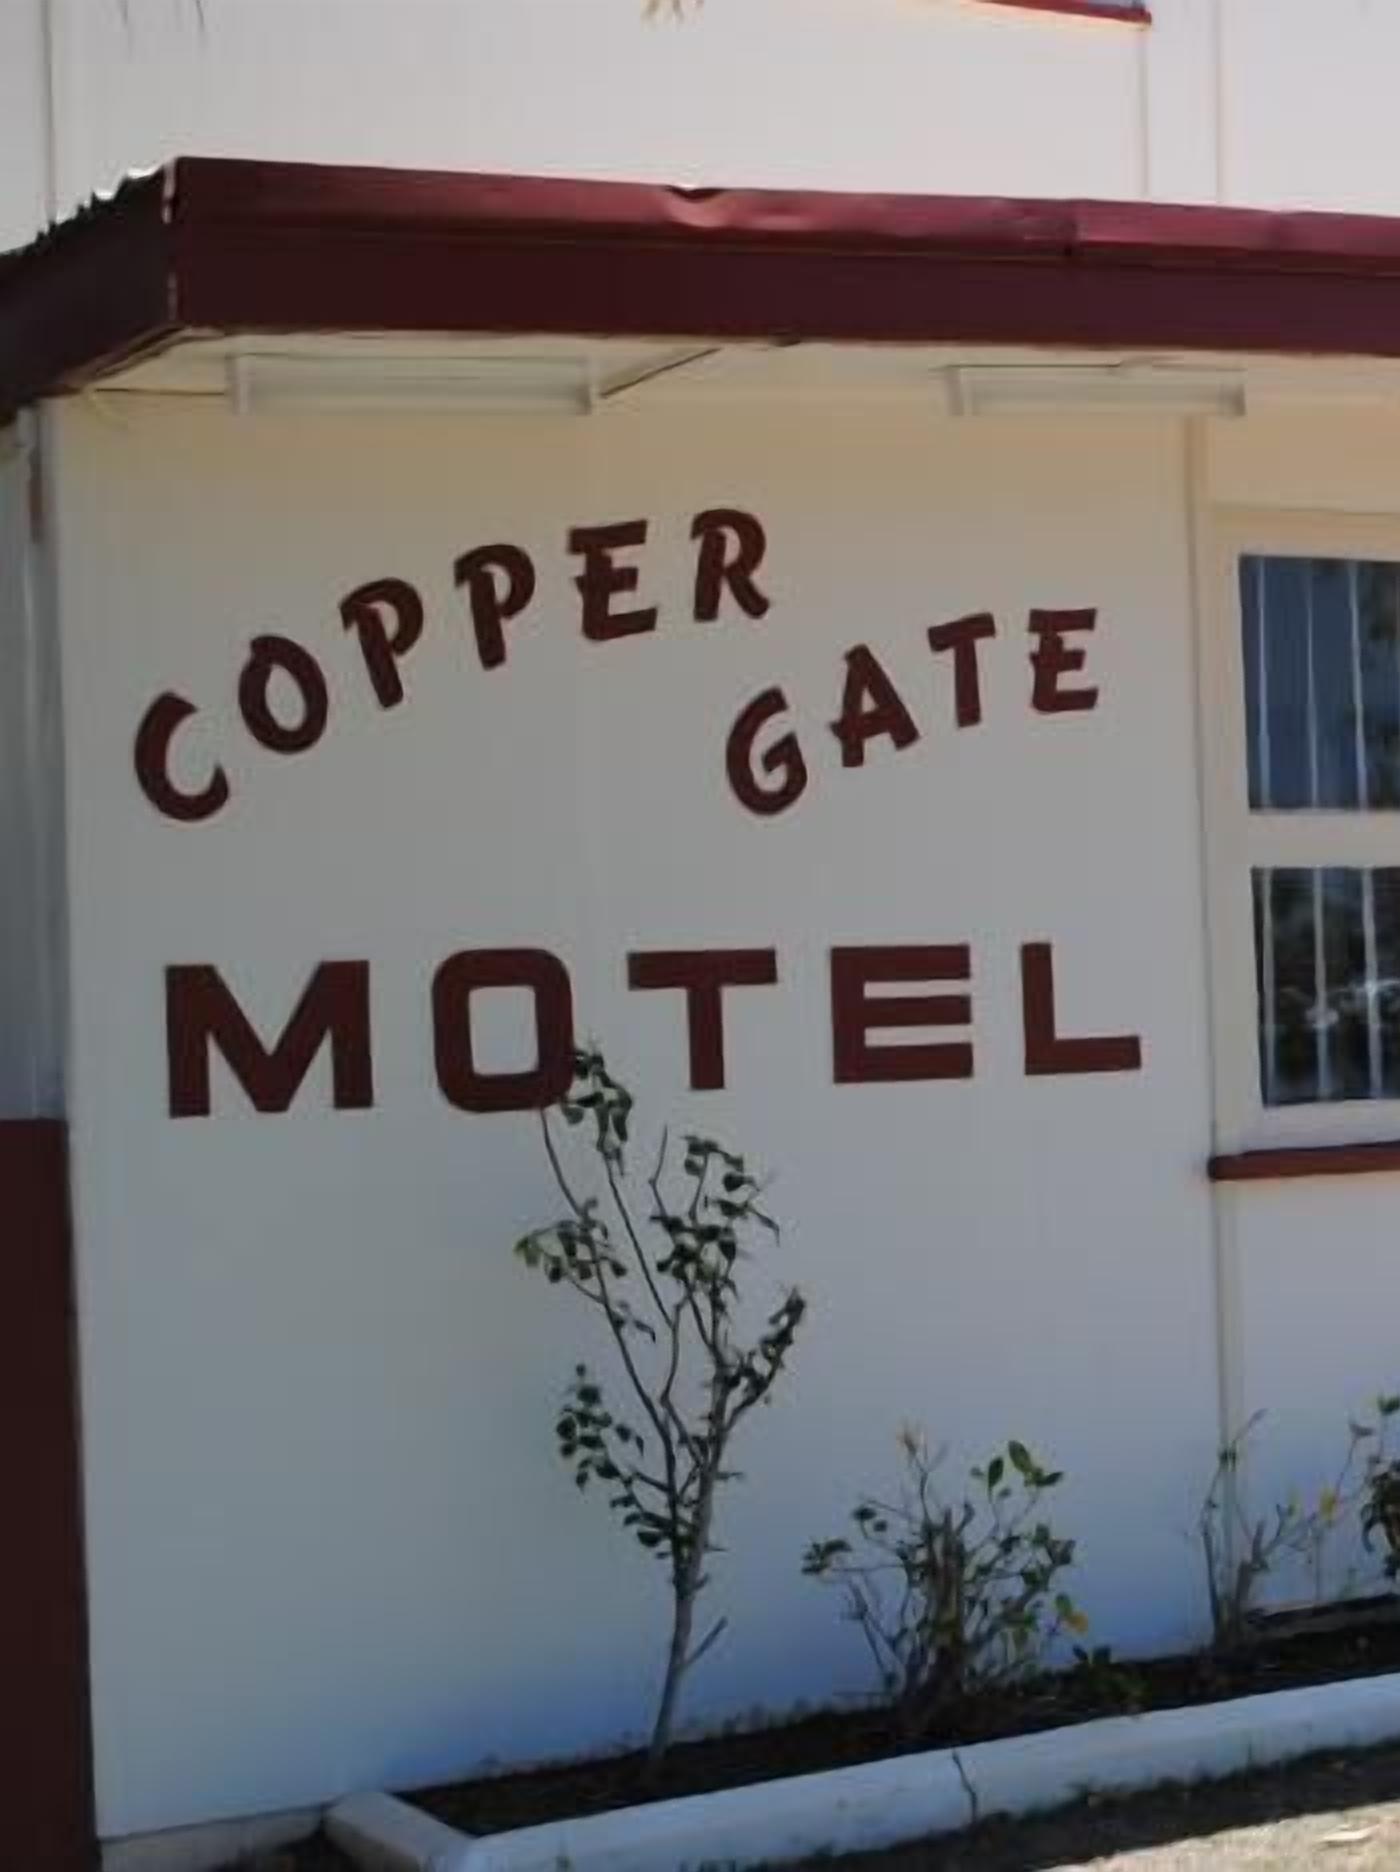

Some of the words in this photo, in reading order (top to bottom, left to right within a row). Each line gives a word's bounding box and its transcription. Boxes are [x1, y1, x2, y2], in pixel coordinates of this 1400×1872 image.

[132, 508, 771, 823] COPPER
[726, 608, 1099, 817] GATE
[165, 941, 1141, 1118] MOTEL
